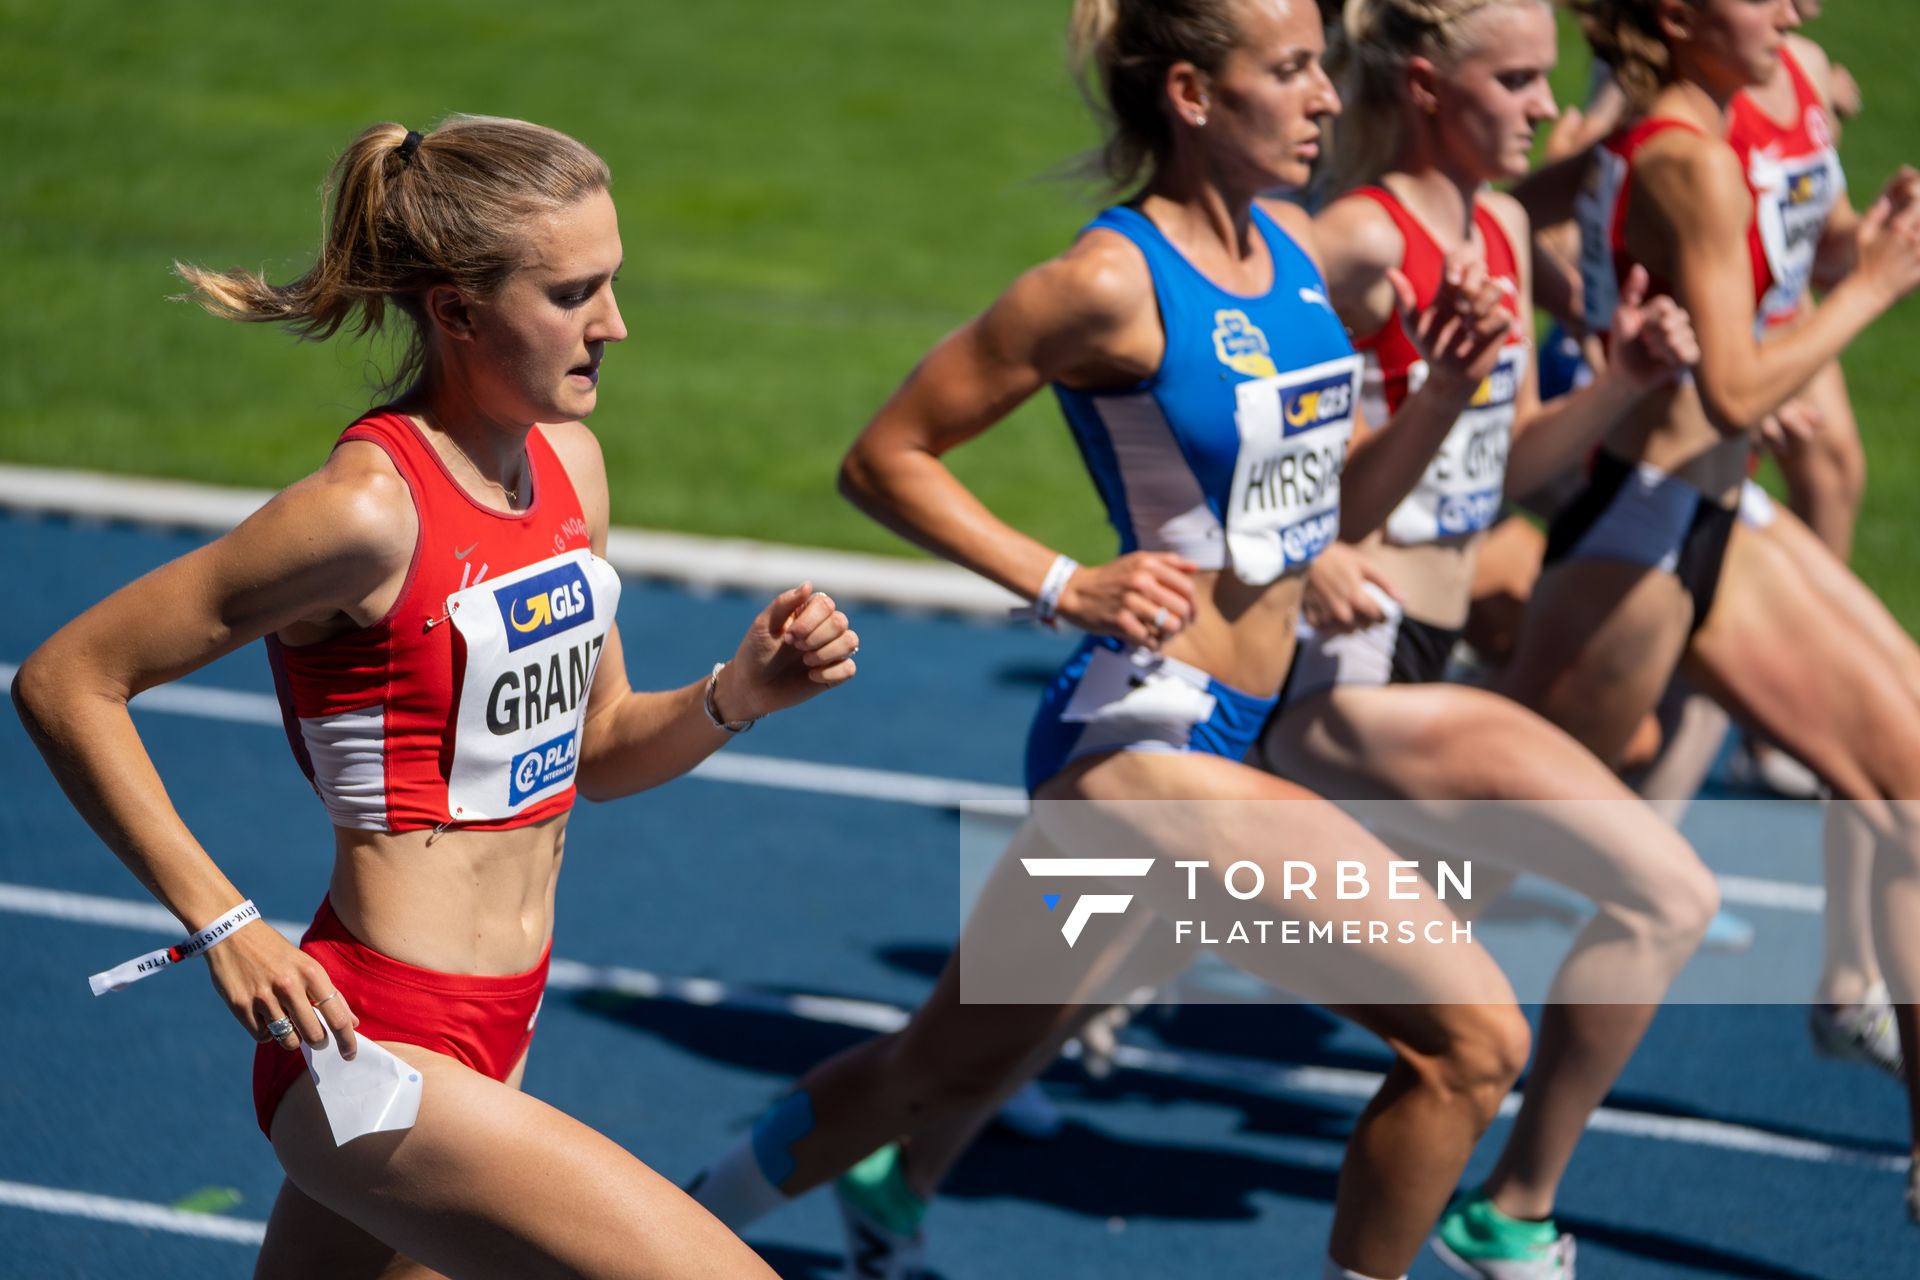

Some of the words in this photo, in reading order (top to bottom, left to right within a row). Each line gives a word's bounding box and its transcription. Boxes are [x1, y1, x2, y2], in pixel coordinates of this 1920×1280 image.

[560, 517, 590, 541] NOR
[550, 580, 586, 620] GLS
[544, 737, 576, 771] PLA
